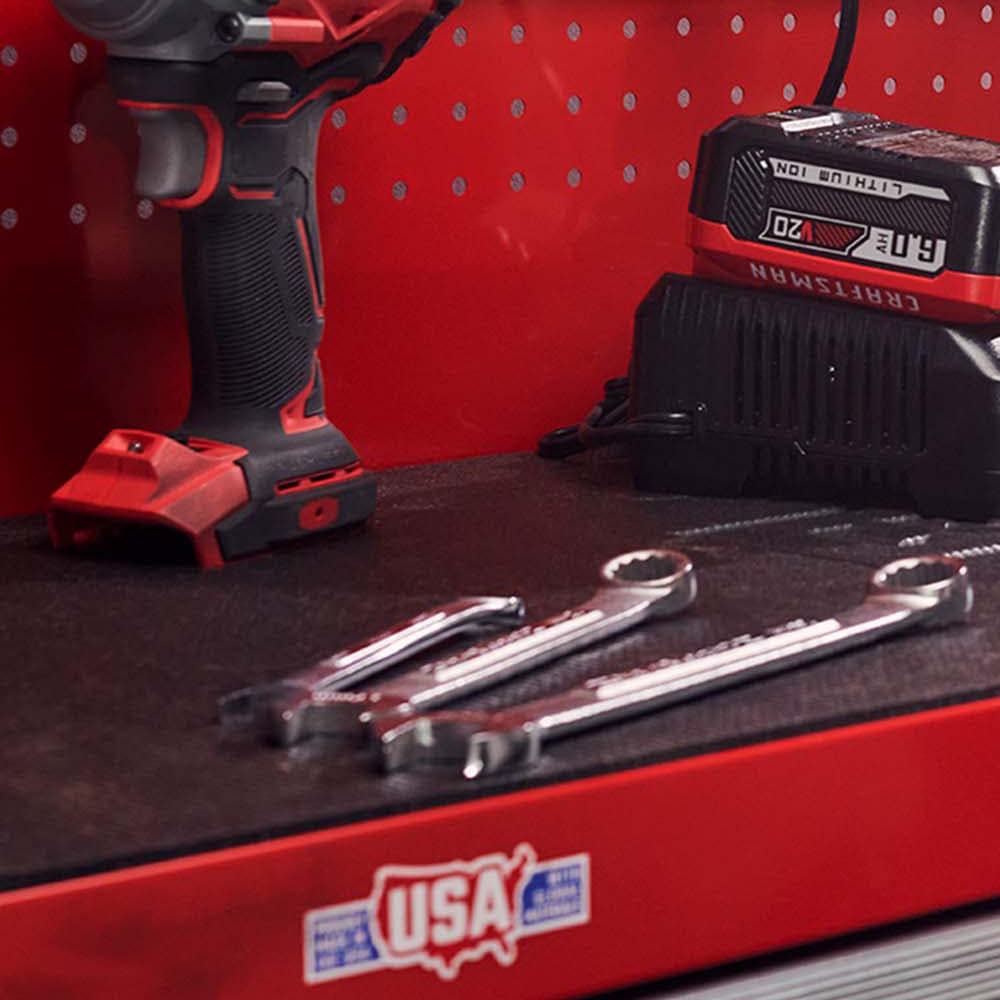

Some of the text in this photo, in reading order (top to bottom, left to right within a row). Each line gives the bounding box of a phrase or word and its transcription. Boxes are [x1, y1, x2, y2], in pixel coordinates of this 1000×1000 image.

[776, 161, 903, 195] LITHIUM ION
[773, 215, 814, 243] V20
[890, 232, 936, 263] 6.0
[750, 262, 921, 312] CRAFTSMAN
[387, 868, 510, 953] USA
